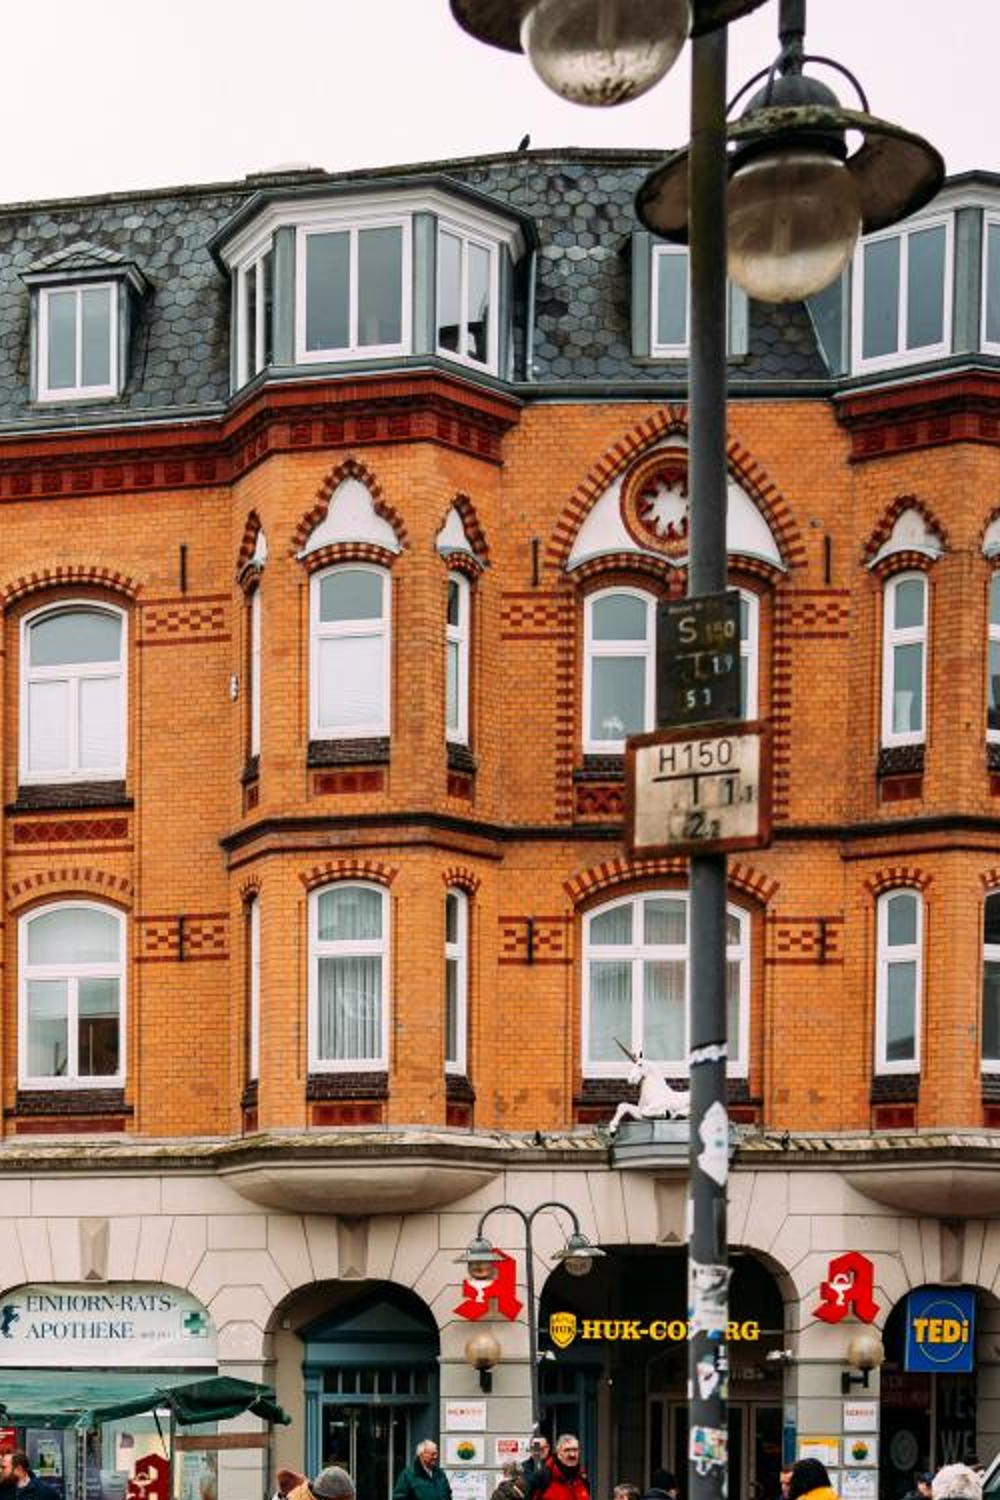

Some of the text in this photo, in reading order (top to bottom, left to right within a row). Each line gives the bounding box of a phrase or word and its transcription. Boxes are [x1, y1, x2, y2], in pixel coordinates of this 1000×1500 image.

[24, 1320, 136, 1340] APOTHEKE
[581, 1318, 761, 1342] HUK-CORG
[913, 1317, 970, 1345] TEDi
